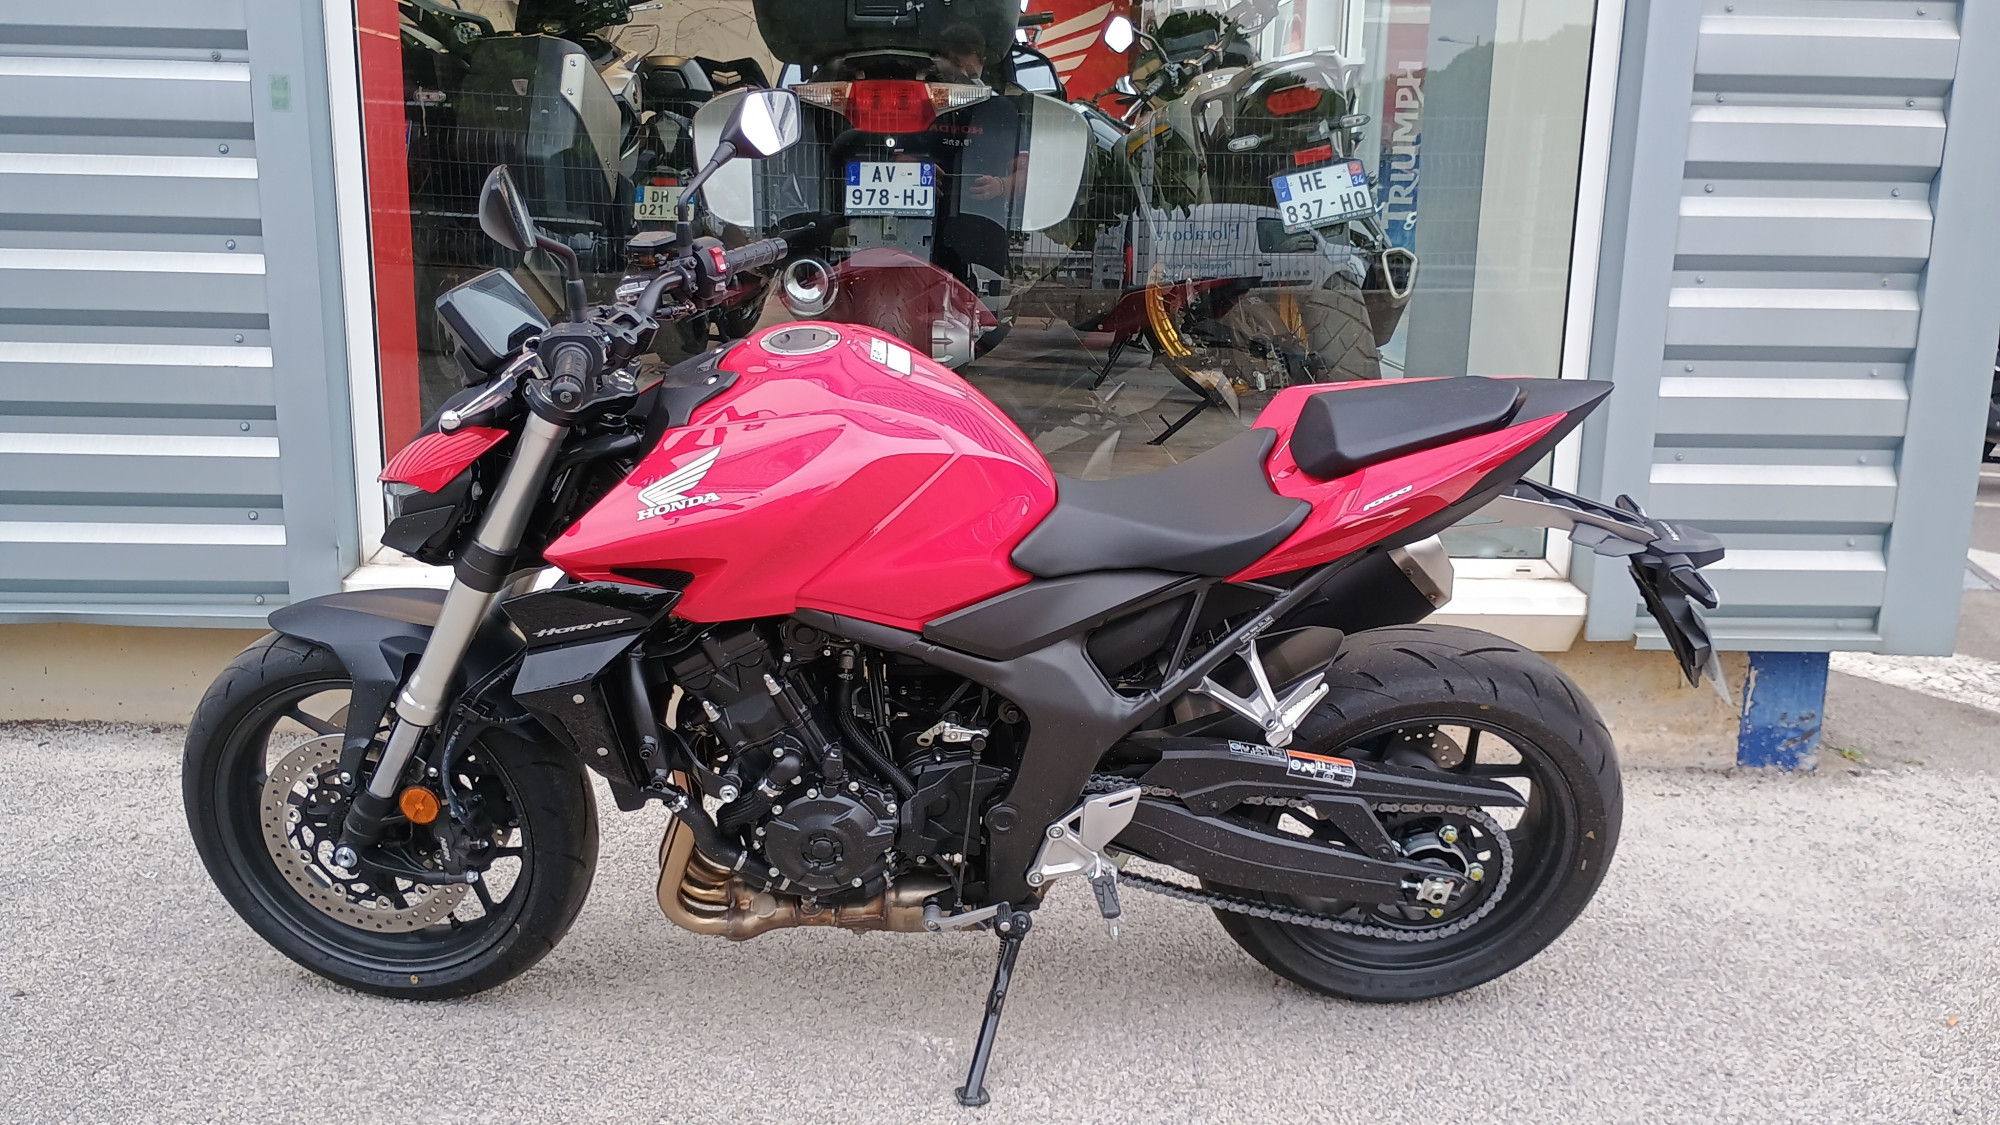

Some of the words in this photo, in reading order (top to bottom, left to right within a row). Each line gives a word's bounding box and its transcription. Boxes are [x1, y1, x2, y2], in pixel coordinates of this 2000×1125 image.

[1381, 61, 1424, 229] TRIUMPH
[872, 166, 895, 182] AV
[921, 176, 932, 185] 07
[1299, 171, 1326, 193] HE
[1351, 175, 1364, 185] 34
[652, 191, 669, 203] DH
[852, 189, 928, 206] 978-HJ
[1286, 190, 1366, 223] 837-HQ
[637, 492, 721, 520] HONDA
[1362, 484, 1413, 511] 1000
[532, 617, 631, 637] HORNET
